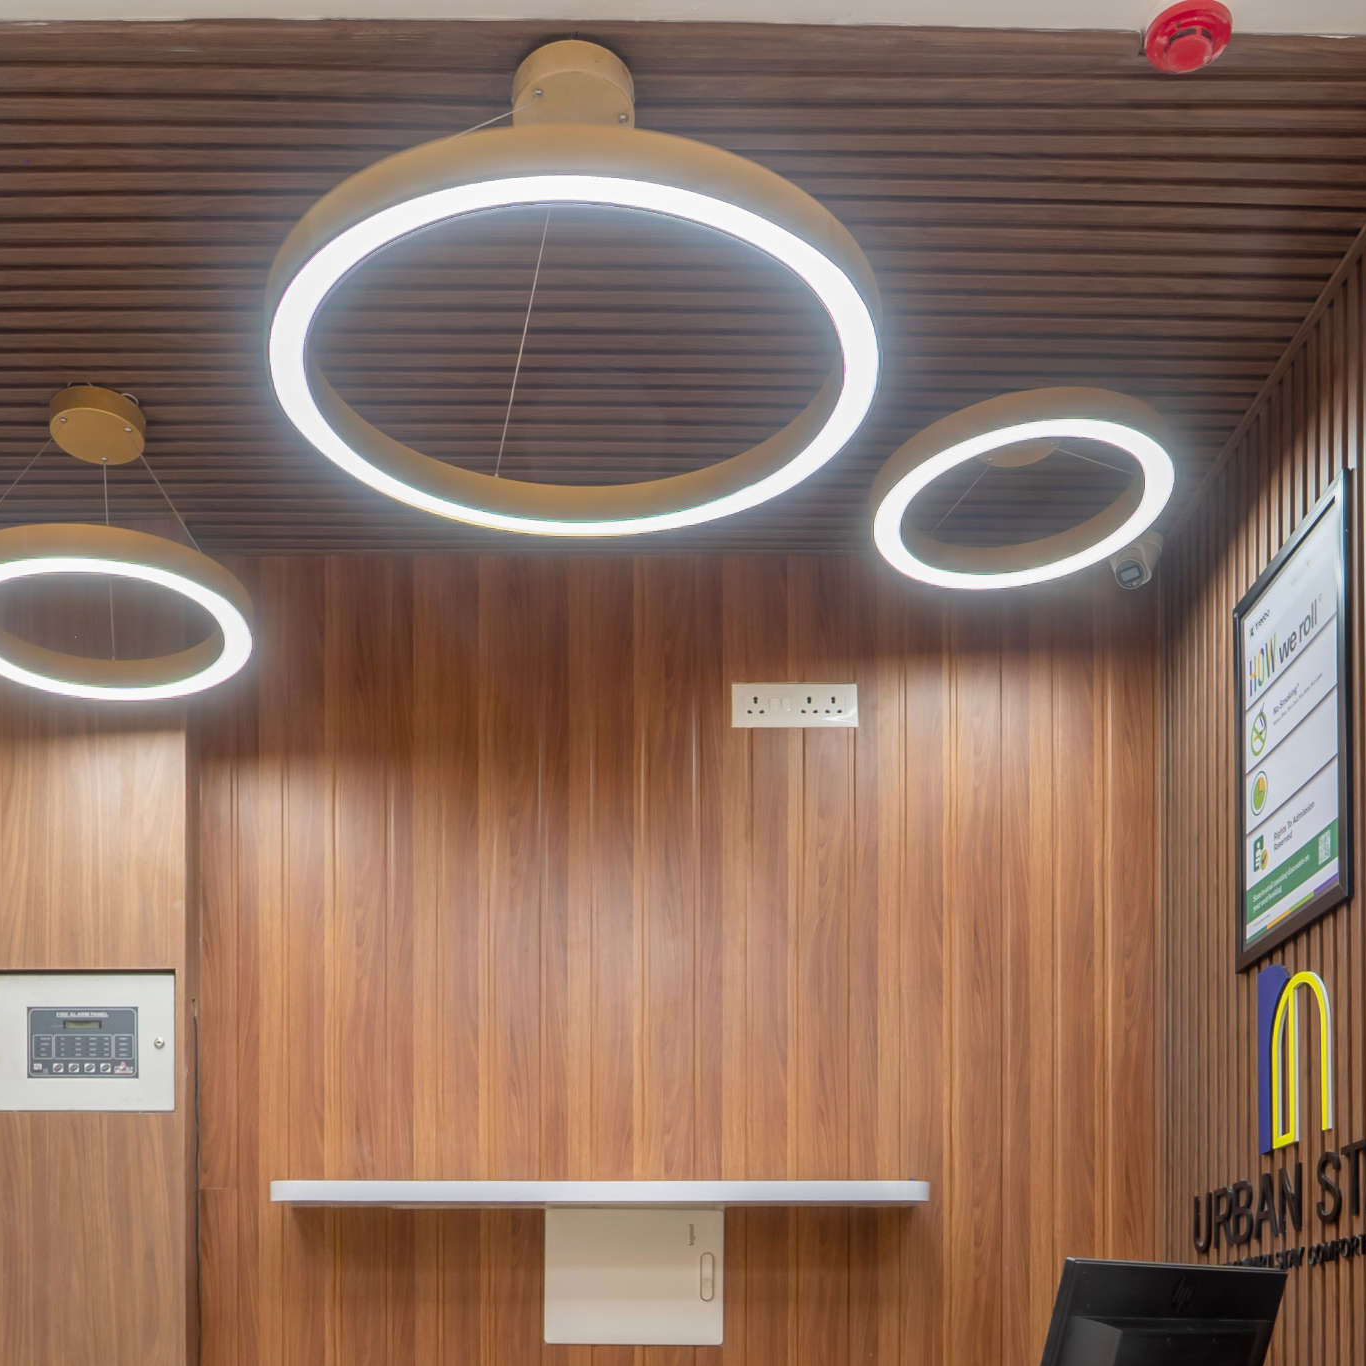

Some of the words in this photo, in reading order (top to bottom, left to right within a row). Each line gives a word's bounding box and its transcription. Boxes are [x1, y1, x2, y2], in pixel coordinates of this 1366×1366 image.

[1249, 632, 1277, 698] HOW
[1278, 631, 1298, 665] we
[1298, 598, 1318, 643] roll
[1273, 825, 1287, 842] Rights
[1292, 801, 1316, 825] Admission
[1193, 1162, 1302, 1253] URBAN
